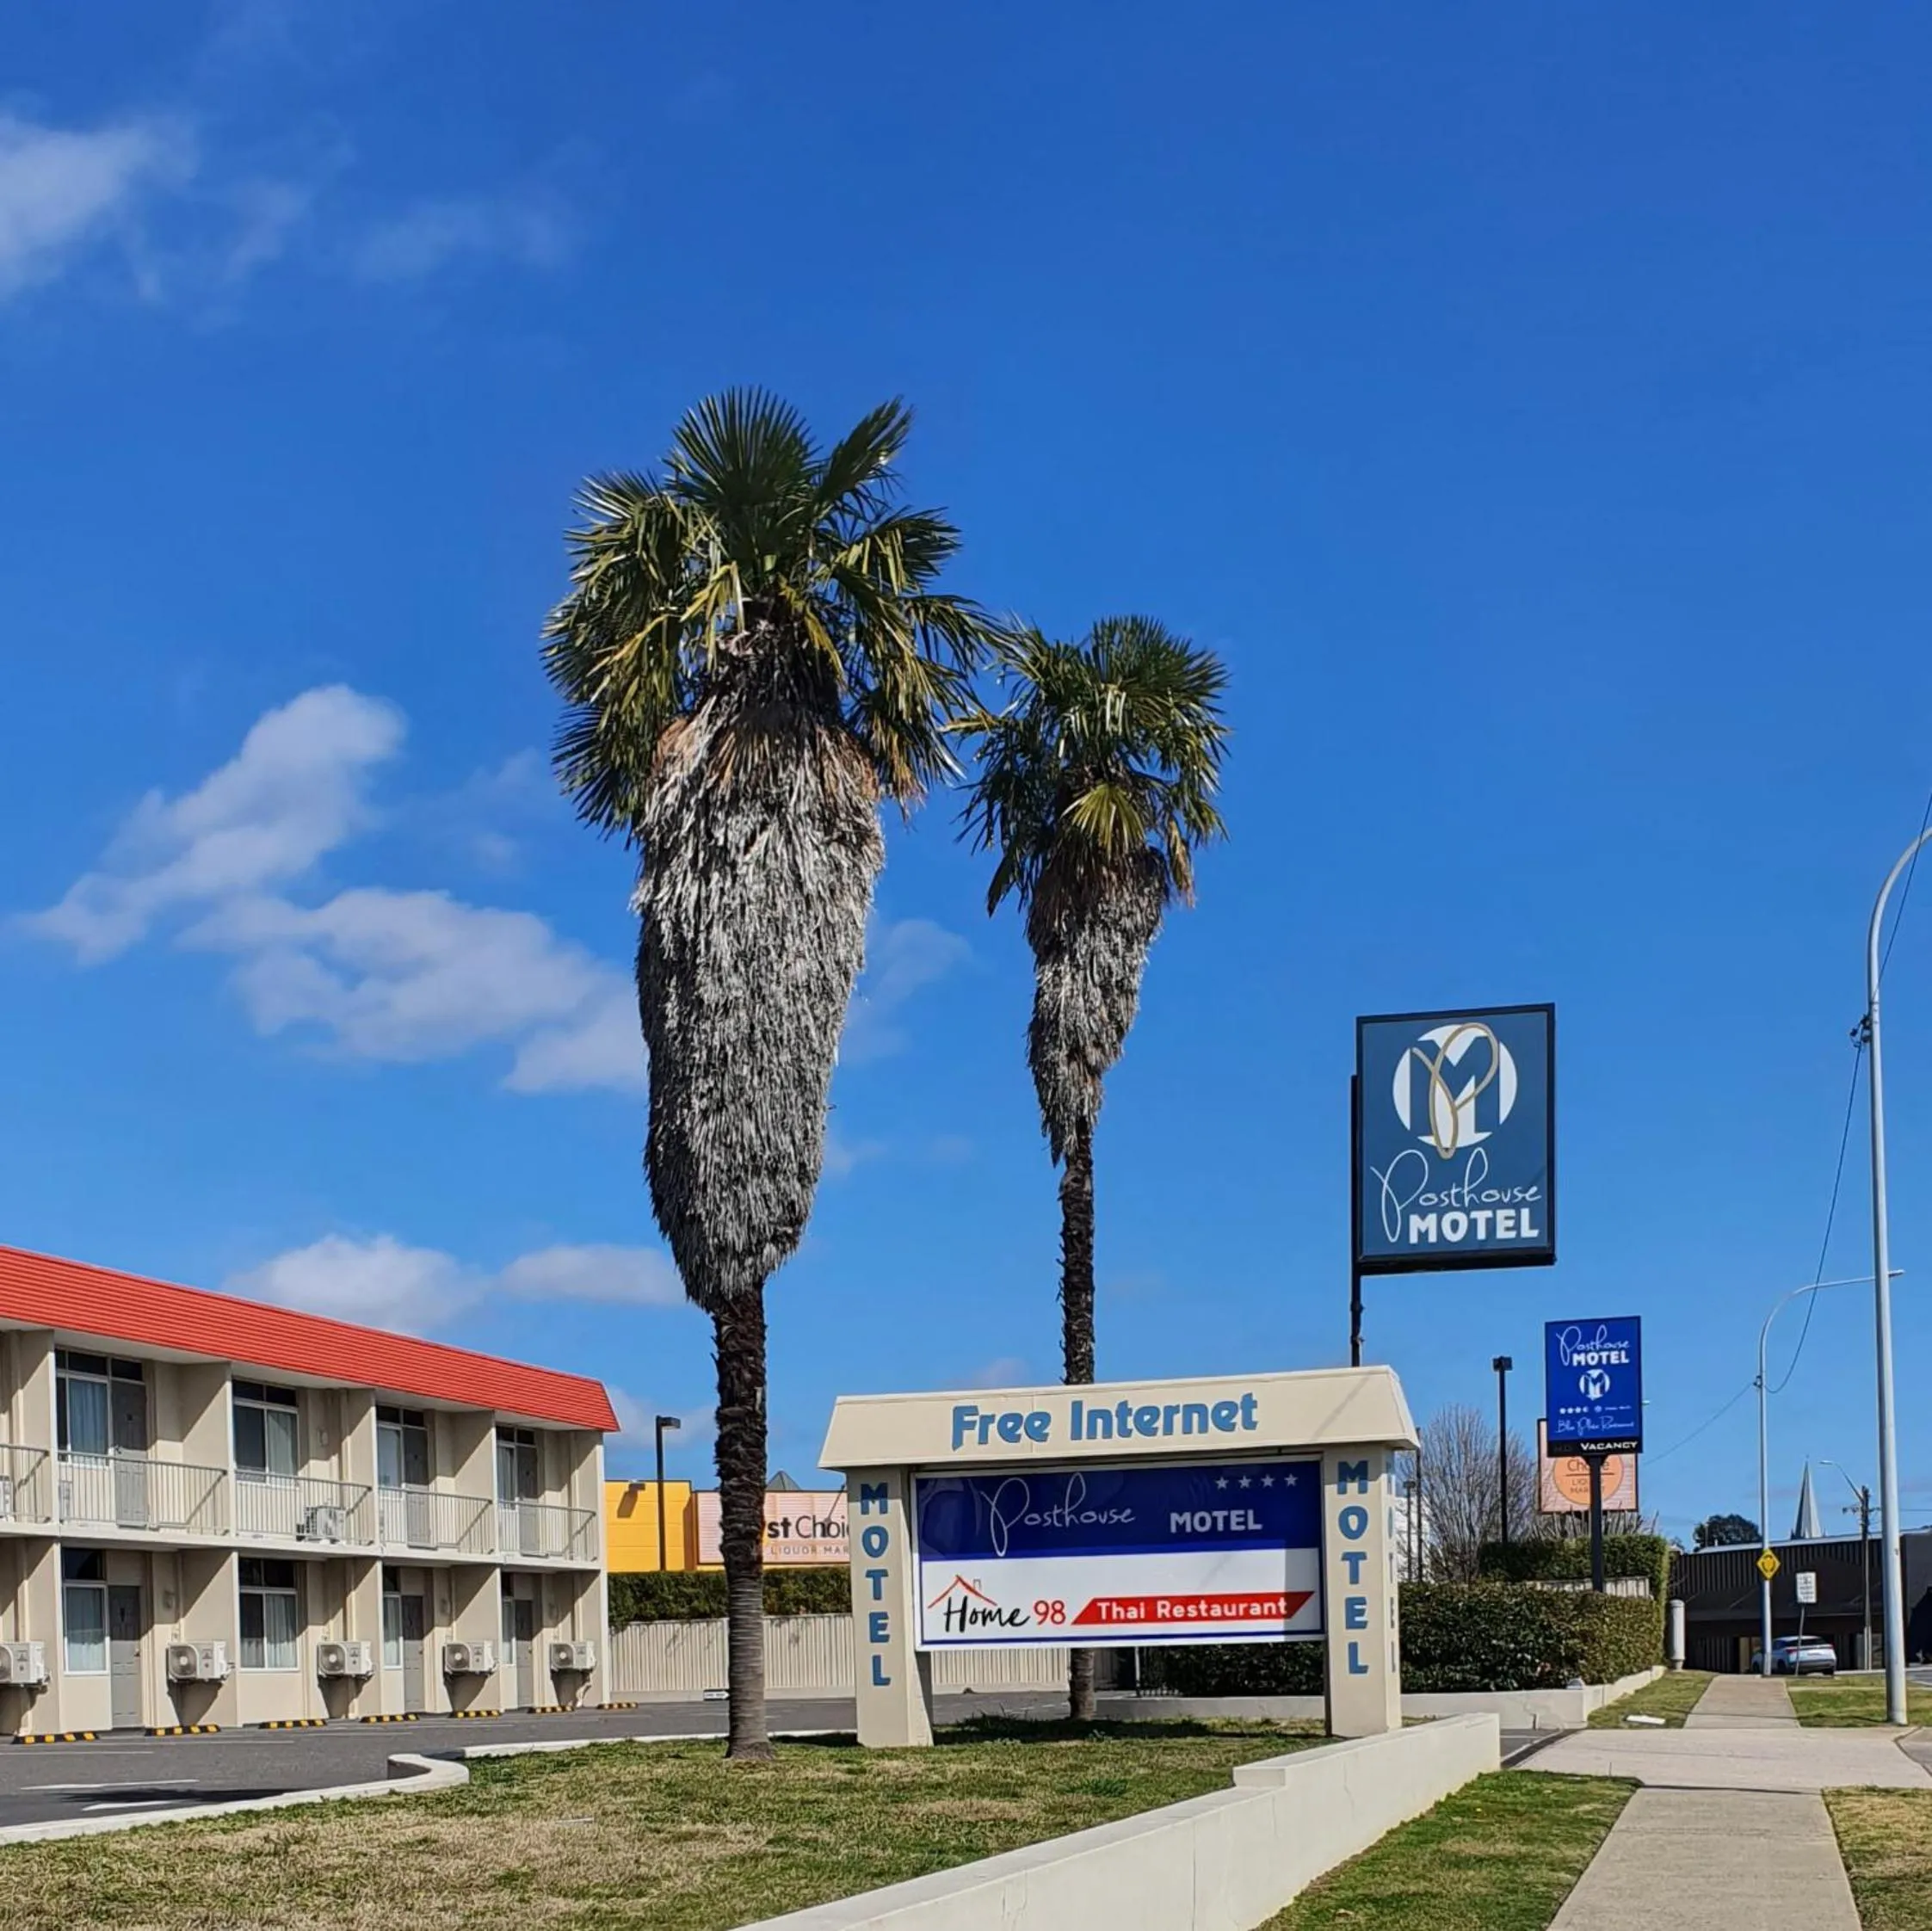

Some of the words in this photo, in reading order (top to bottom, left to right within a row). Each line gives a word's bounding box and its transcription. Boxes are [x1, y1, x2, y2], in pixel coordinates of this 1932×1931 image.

[1370, 1147, 1541, 1243] Posthouse
[1409, 1207, 1540, 1244] MOTEL
[1556, 1324, 1630, 1367] Posthouse
[1572, 1350, 1630, 1367] MOTEL
[952, 1404, 1052, 1452] Free
[1070, 1392, 1258, 1441] Internet
[1580, 1441, 1638, 1451] VACANCY
[795, 1515, 849, 1539] Choi
[980, 1471, 1136, 1557] Posthouse
[1170, 1509, 1263, 1533] MOTEL
[771, 1545, 818, 1556] LIQUOR
[1336, 1460, 1369, 1675] MOTEL
[861, 1482, 891, 1687] MOTEL
[943, 1595, 1031, 1633] Home
[1034, 1600, 1066, 1625] 98
[1097, 1601, 1145, 1619] Thai
[1157, 1596, 1287, 1619] Restaurant
